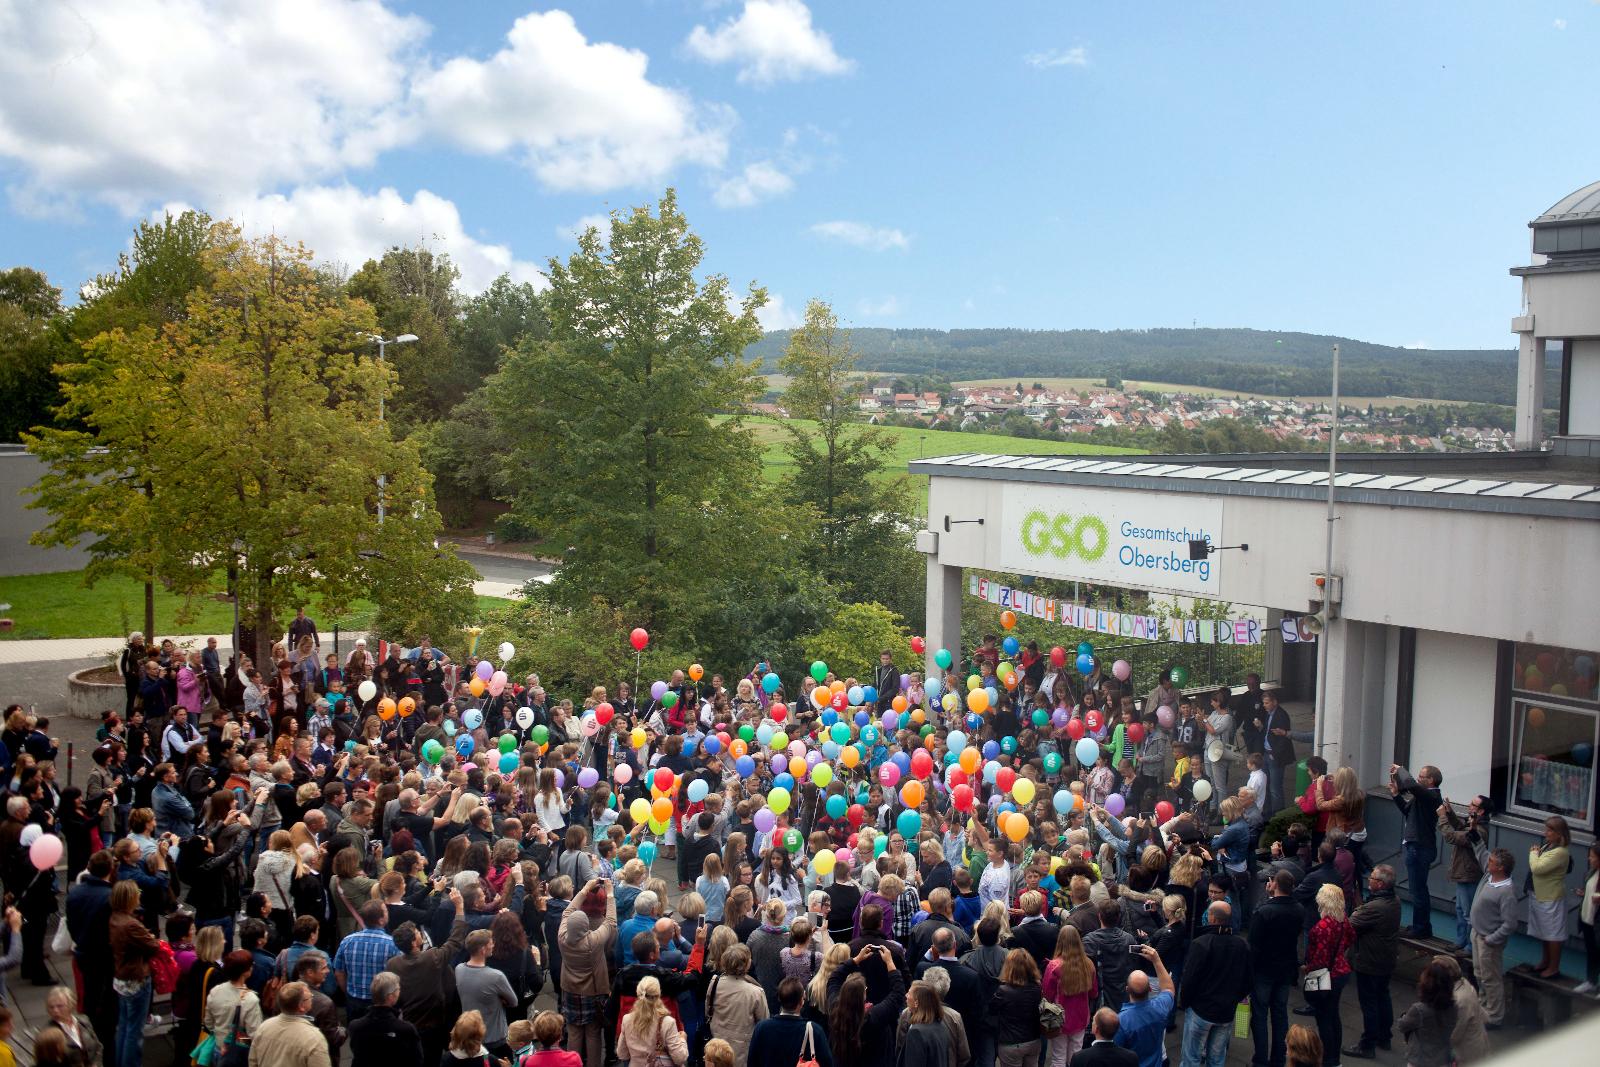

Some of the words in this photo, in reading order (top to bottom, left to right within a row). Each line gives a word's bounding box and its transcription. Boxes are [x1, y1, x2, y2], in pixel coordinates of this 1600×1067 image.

[1021, 509, 1109, 562] GSO
[1120, 520, 1211, 545] Gesamtschule
[1119, 545, 1210, 582] Obersberg
[1215, 620, 1256, 641] DER
[1177, 725, 1193, 743] 78
